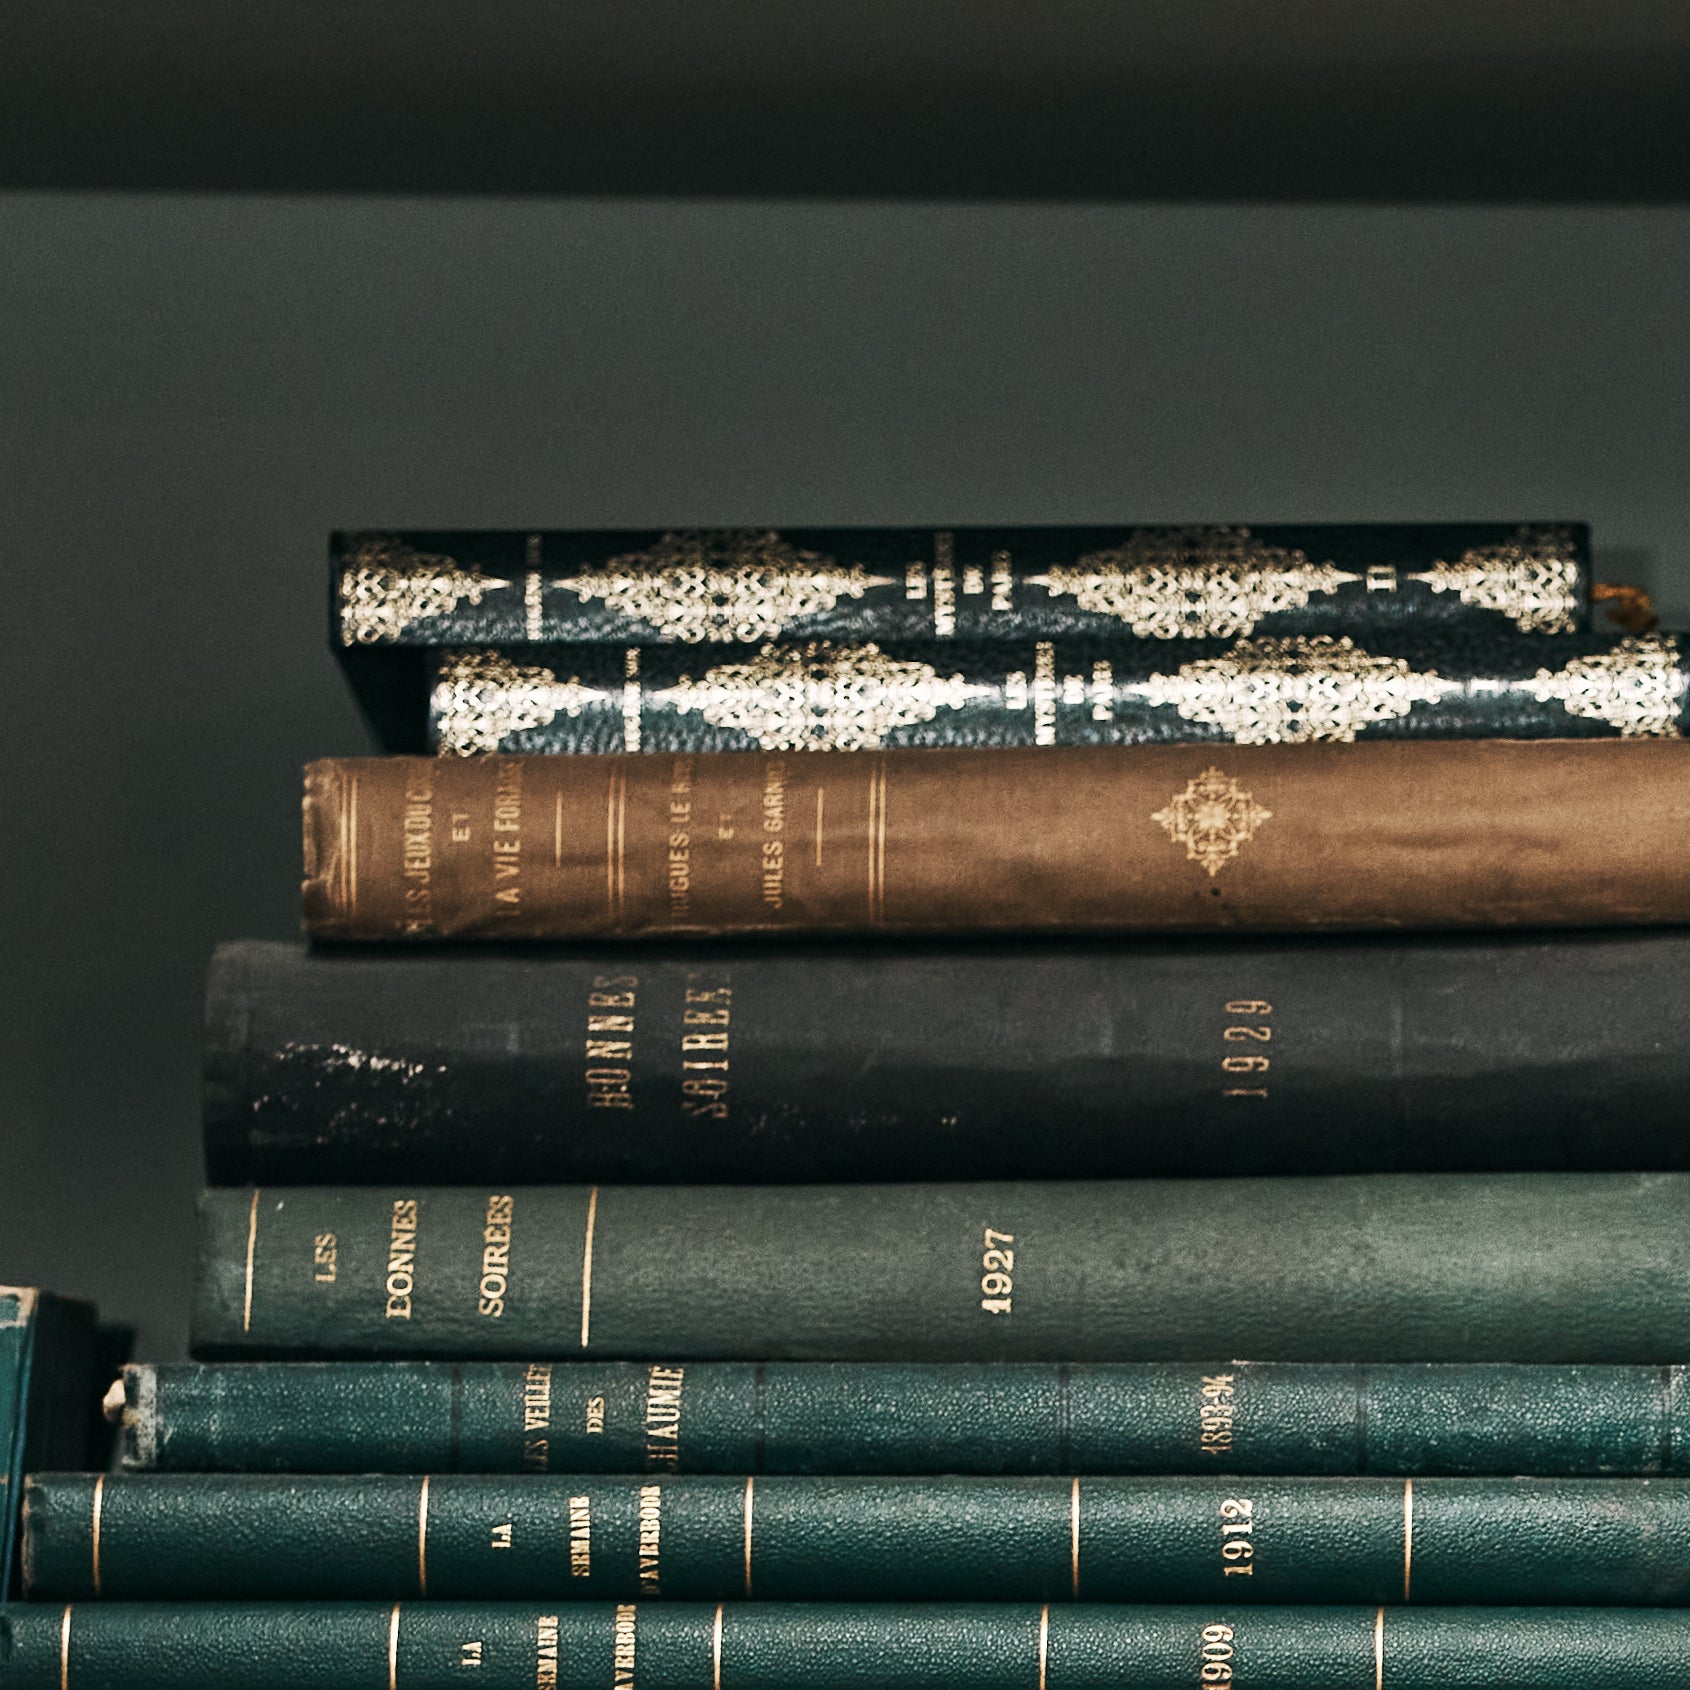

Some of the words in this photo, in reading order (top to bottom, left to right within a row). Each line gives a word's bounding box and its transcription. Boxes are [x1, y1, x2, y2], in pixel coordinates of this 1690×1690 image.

[452, 812, 470, 841] ET
[670, 802, 690, 823] LE
[494, 840, 521, 878] VIE
[762, 841, 784, 909] JULES
[1221, 1000, 1273, 1098] 1929
[314, 1233, 337, 1283] LES
[981, 1228, 1014, 1314] 1927
[586, 1397, 604, 1434] DES
[1200, 1375, 1234, 1455] 1893-94
[491, 1524, 512, 1548] LA
[569, 1496, 590, 1577] SEMAINE
[1220, 1499, 1253, 1576] 1912
[461, 1642, 482, 1665] LA
